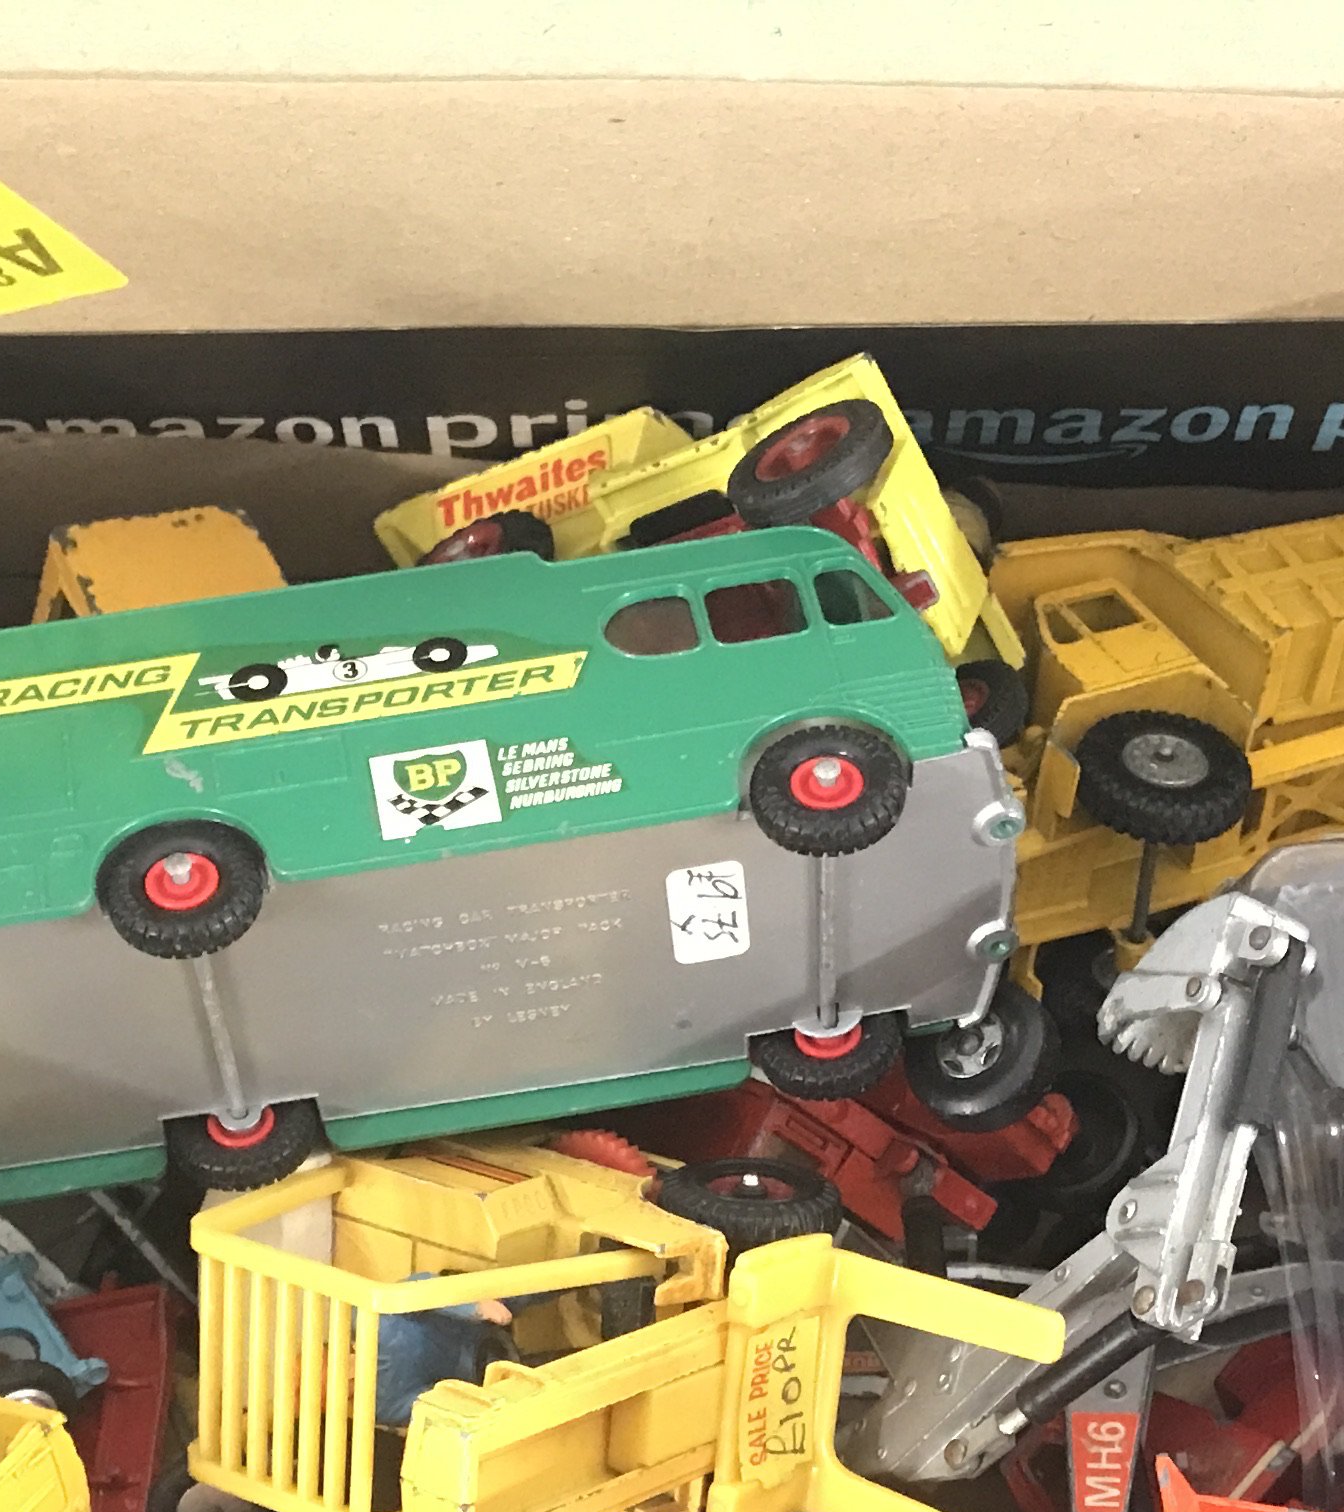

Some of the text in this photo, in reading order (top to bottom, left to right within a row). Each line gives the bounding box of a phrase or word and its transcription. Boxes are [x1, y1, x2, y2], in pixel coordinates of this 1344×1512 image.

[438, 450, 606, 527] Thwaites
[341, 660, 359, 680] 3
[180, 664, 557, 741] TRANSPORTER
[405, 758, 461, 792] BP
[497, 737, 569, 761] LE MANS
[505, 763, 613, 794] SILVERSTONE
[748, 1339, 773, 1466] SALE PRICE
[1084, 1420, 1126, 1509] MH6
